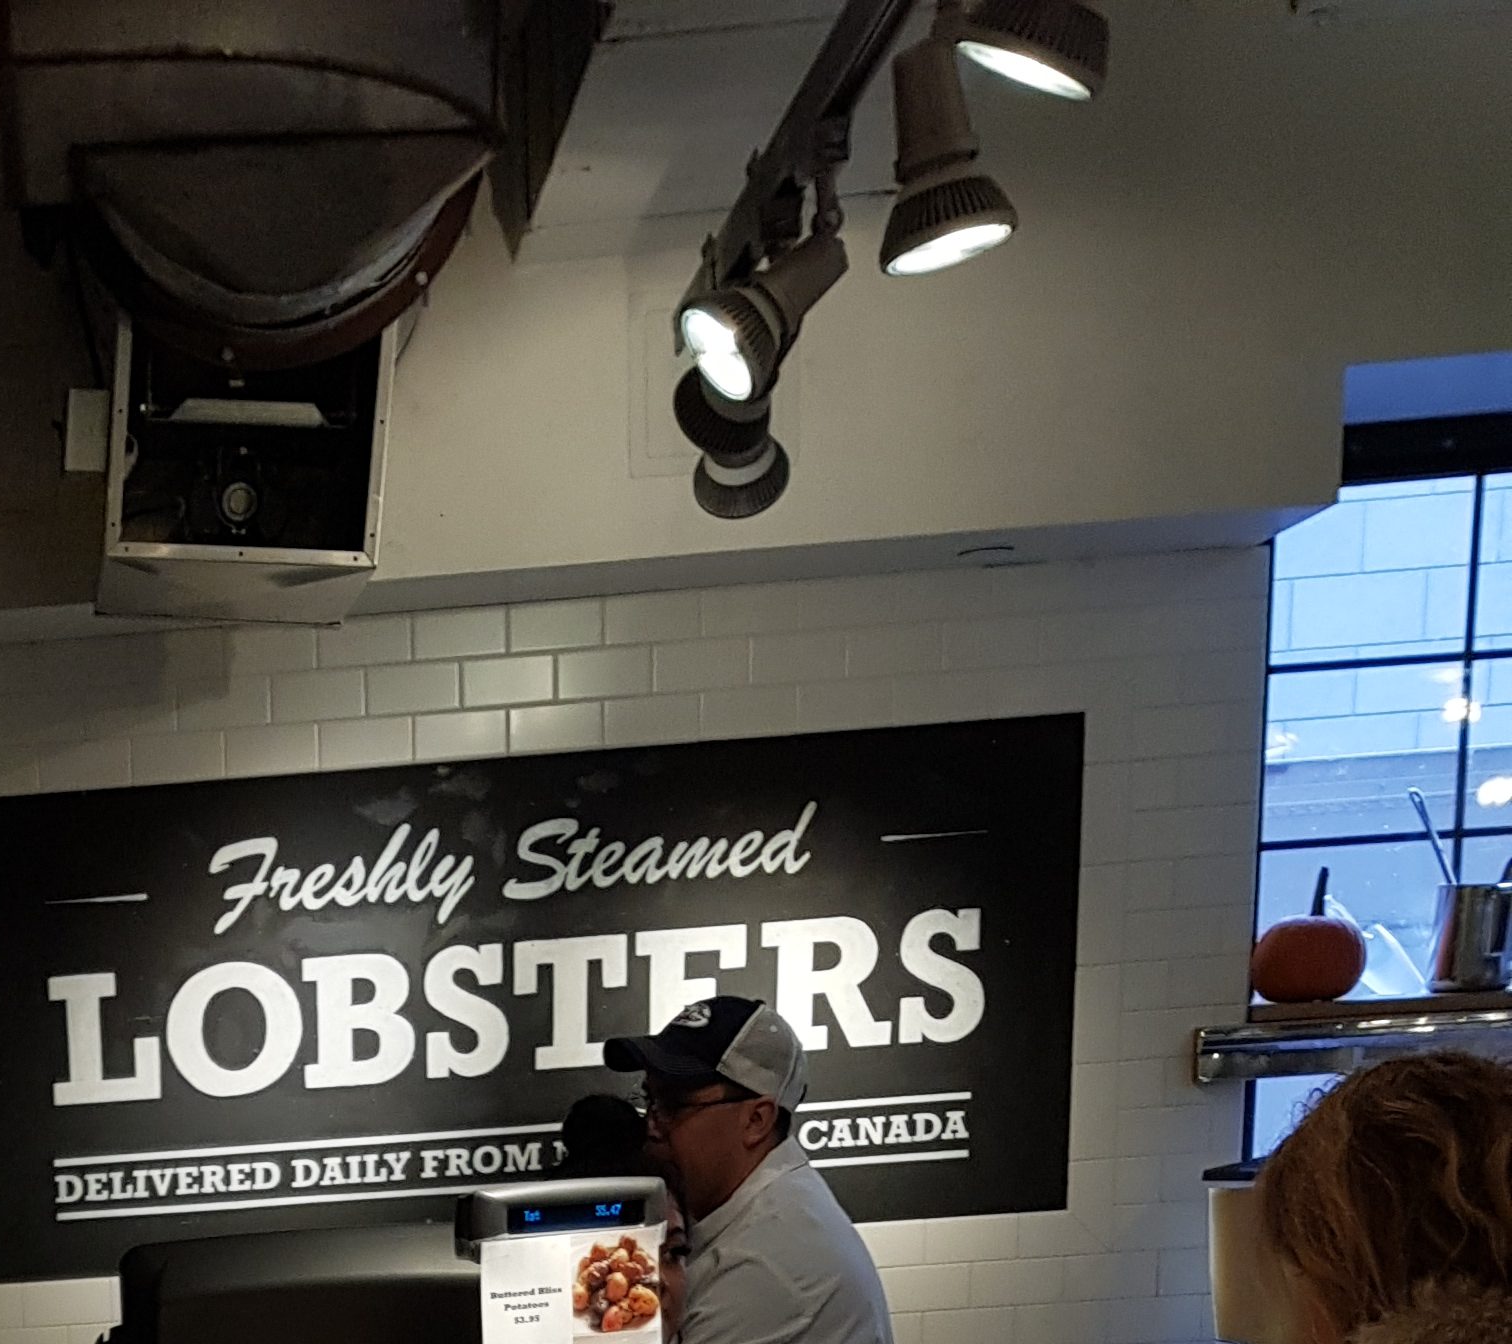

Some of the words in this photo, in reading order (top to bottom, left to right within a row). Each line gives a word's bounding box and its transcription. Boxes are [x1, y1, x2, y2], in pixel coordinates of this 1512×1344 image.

[208, 823, 476, 936] Freshly
[501, 801, 818, 901] Steamed
[799, 1110, 971, 1147] CANADA
[56, 1156, 281, 1205] DELIVERED
[291, 1148, 408, 1189] DAILY
[418, 1139, 543, 1180] FROM
[490, 1287, 536, 1300] Buttered
[538, 1286, 563, 1295] Bliss
[503, 1301, 550, 1311] Potatoes
